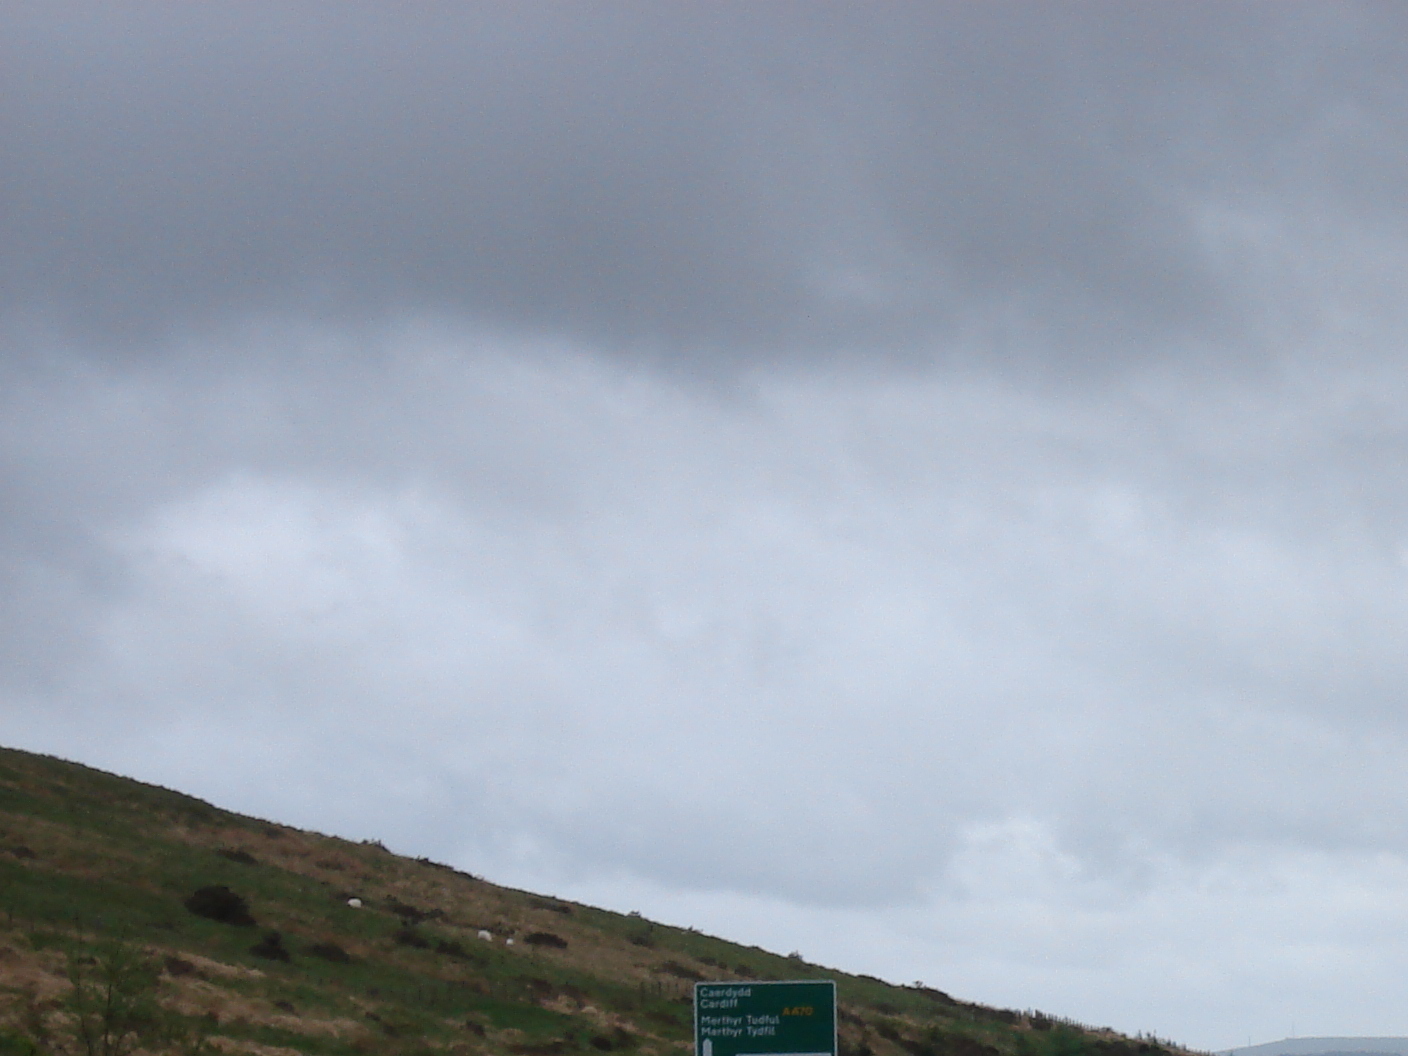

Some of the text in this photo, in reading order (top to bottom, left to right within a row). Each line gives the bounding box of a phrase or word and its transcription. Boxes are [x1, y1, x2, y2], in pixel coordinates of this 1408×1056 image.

[700, 988, 751, 998] Caerdydd
[700, 998, 738, 1009] Cardiff
[783, 1007, 813, 1016] A470
[701, 1015, 780, 1026] Merthyr Tudful
[701, 1026, 775, 1037] Merthyr Tydfil
